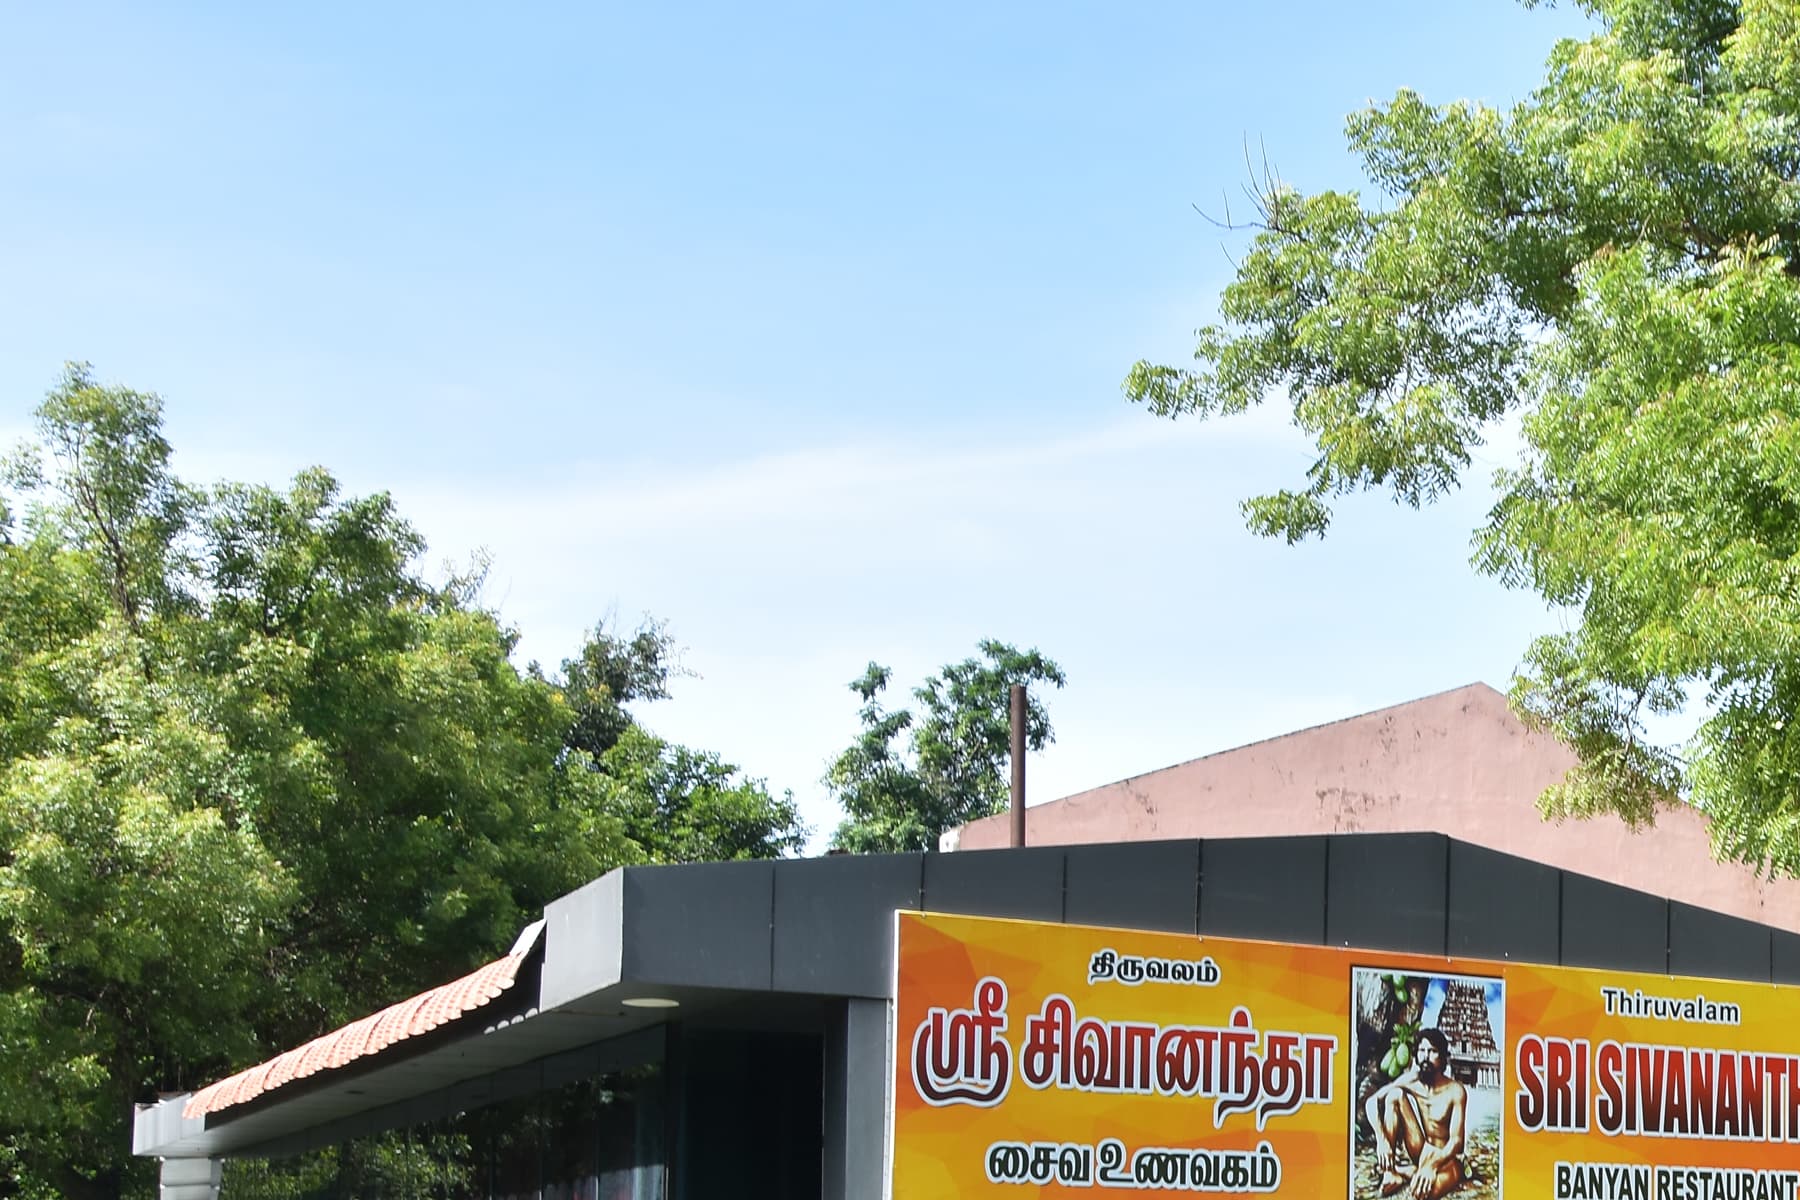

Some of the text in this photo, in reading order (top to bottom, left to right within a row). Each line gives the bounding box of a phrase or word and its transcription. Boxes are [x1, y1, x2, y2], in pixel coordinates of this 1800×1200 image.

[1090, 951, 1219, 983] திருவலம்
[1603, 988, 1740, 1024] Thiruvalam
[1022, 997, 1337, 1129] சிவானந்தா
[1518, 1036, 1589, 1132] SRI
[988, 1141, 1280, 1190] சைவ உணவகம்
